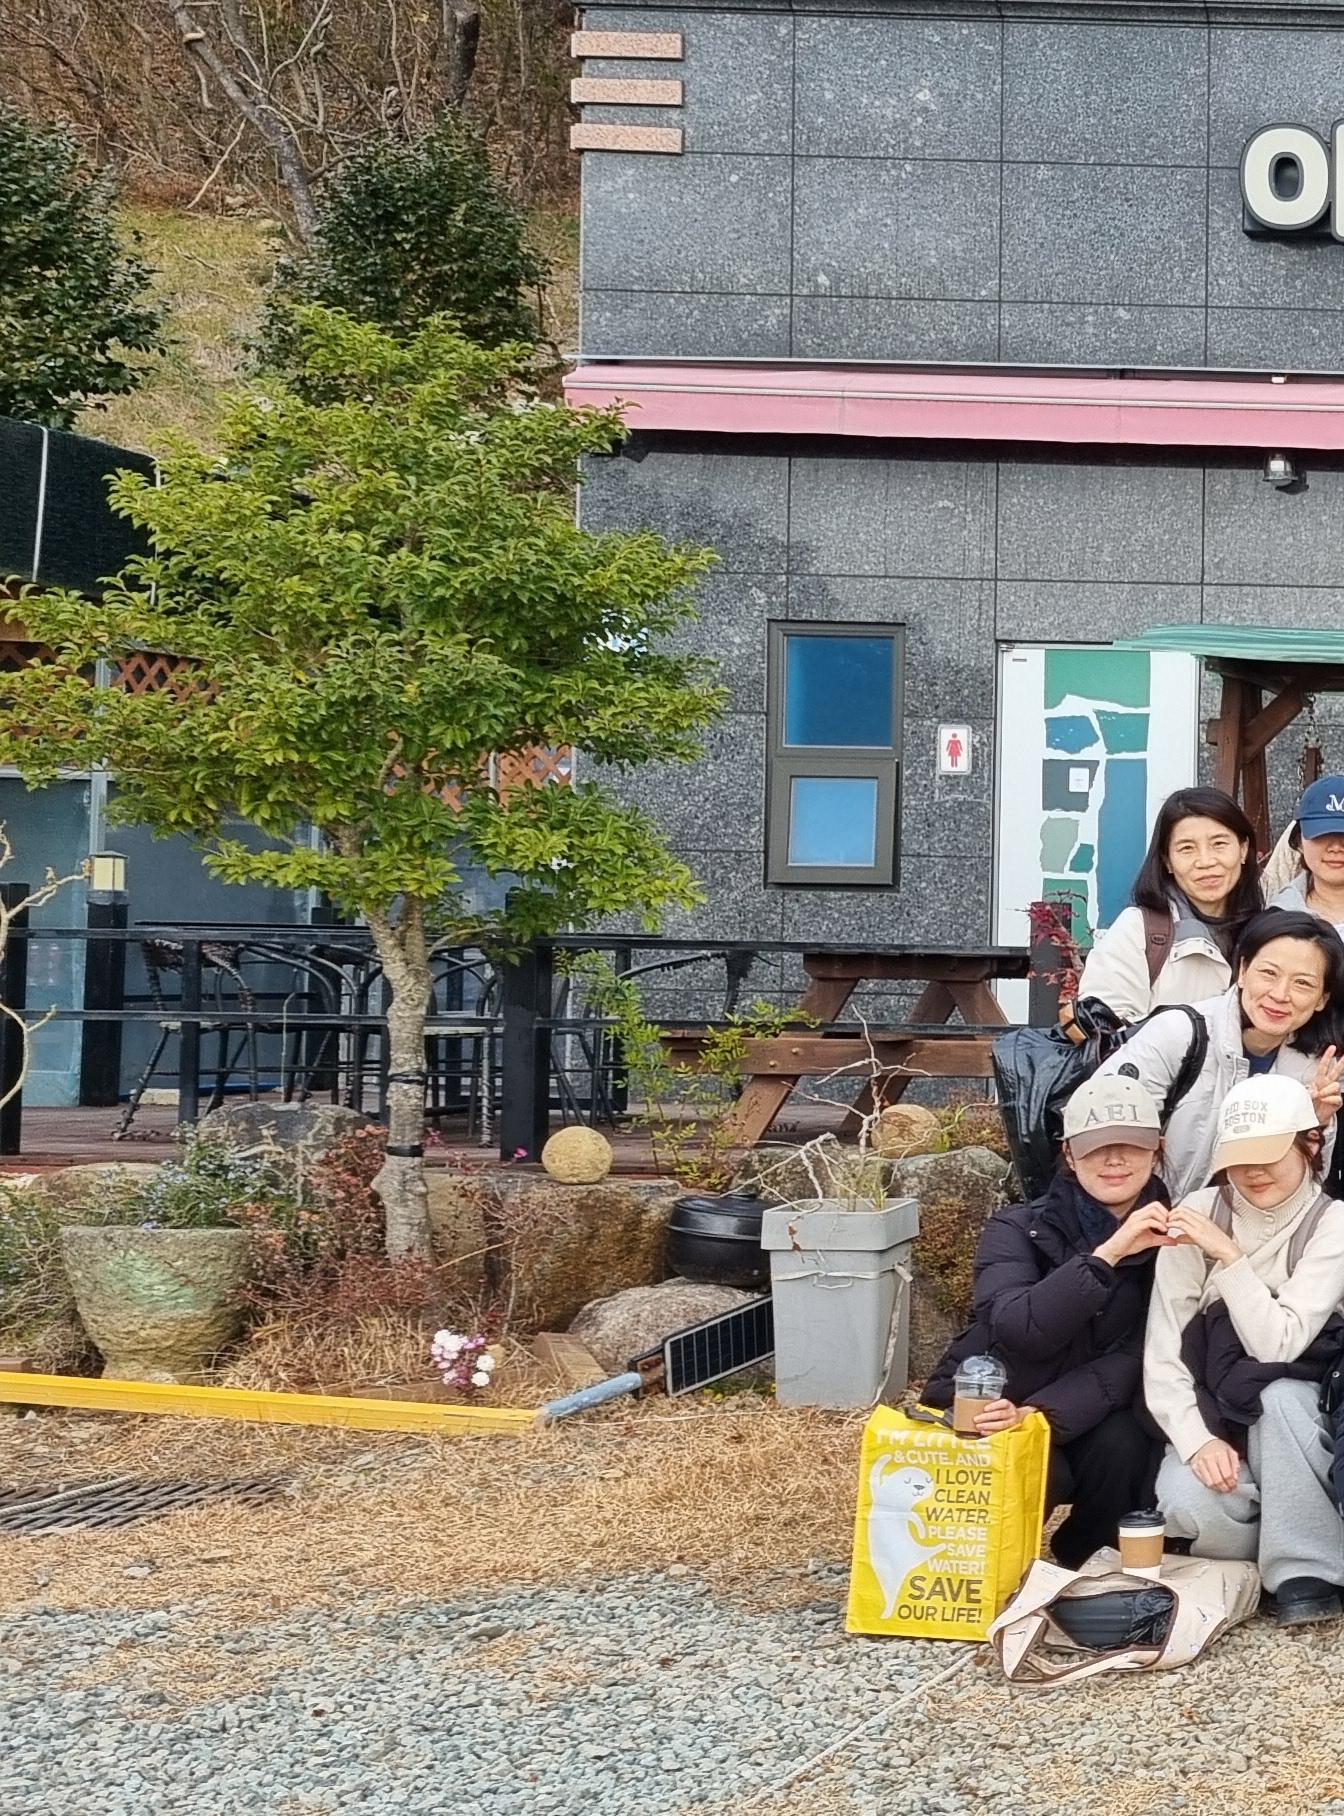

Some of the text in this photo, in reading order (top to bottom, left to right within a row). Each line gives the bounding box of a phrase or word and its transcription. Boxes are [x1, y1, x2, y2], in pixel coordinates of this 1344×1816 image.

[1243, 1099, 1268, 1112] SOX
[1084, 1103, 1142, 1127] AEI
[1224, 1111, 1266, 1129] BOSTON
[877, 1428, 911, 1445] I'M
[956, 1453, 992, 1467] AND
[945, 1469, 992, 1486] LOVE
[934, 1489, 991, 1506] CLEAN
[926, 1507, 990, 1524] WATER.
[928, 1526, 988, 1541] PLEASE
[946, 1544, 986, 1556] SAVE
[927, 1559, 985, 1575] WATER!
[908, 1576, 983, 1604] SAVE
[899, 1604, 982, 1624] OUR LIFE!
